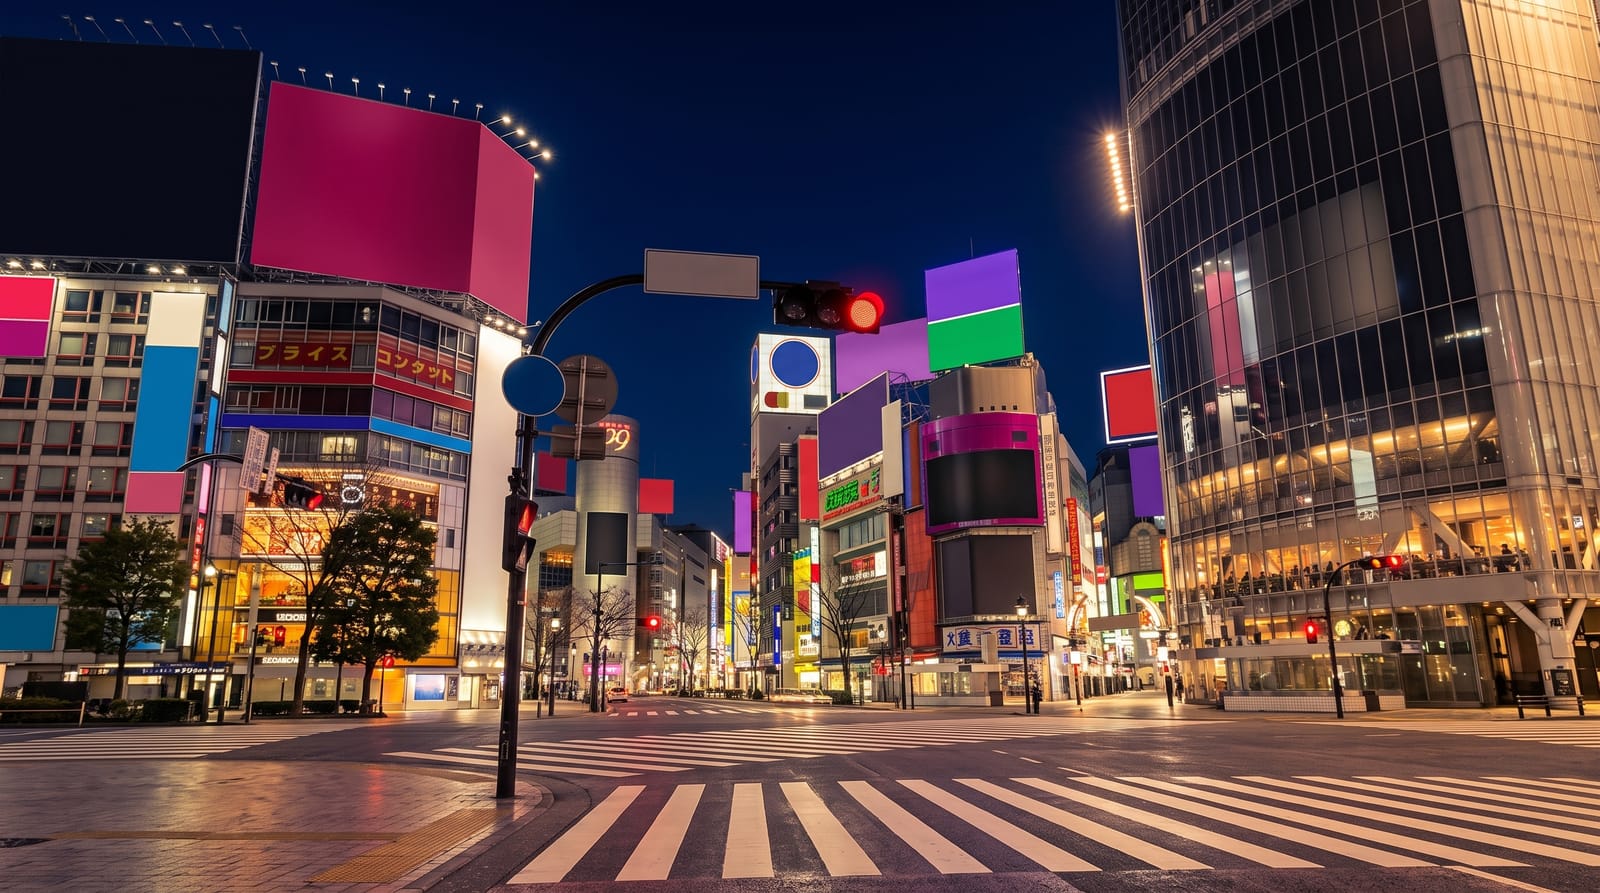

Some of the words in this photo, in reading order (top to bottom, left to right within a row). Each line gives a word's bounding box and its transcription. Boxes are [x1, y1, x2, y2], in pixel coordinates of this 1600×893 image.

[258, 345, 348, 362] ブライス
[378, 349, 453, 384] コンタット
